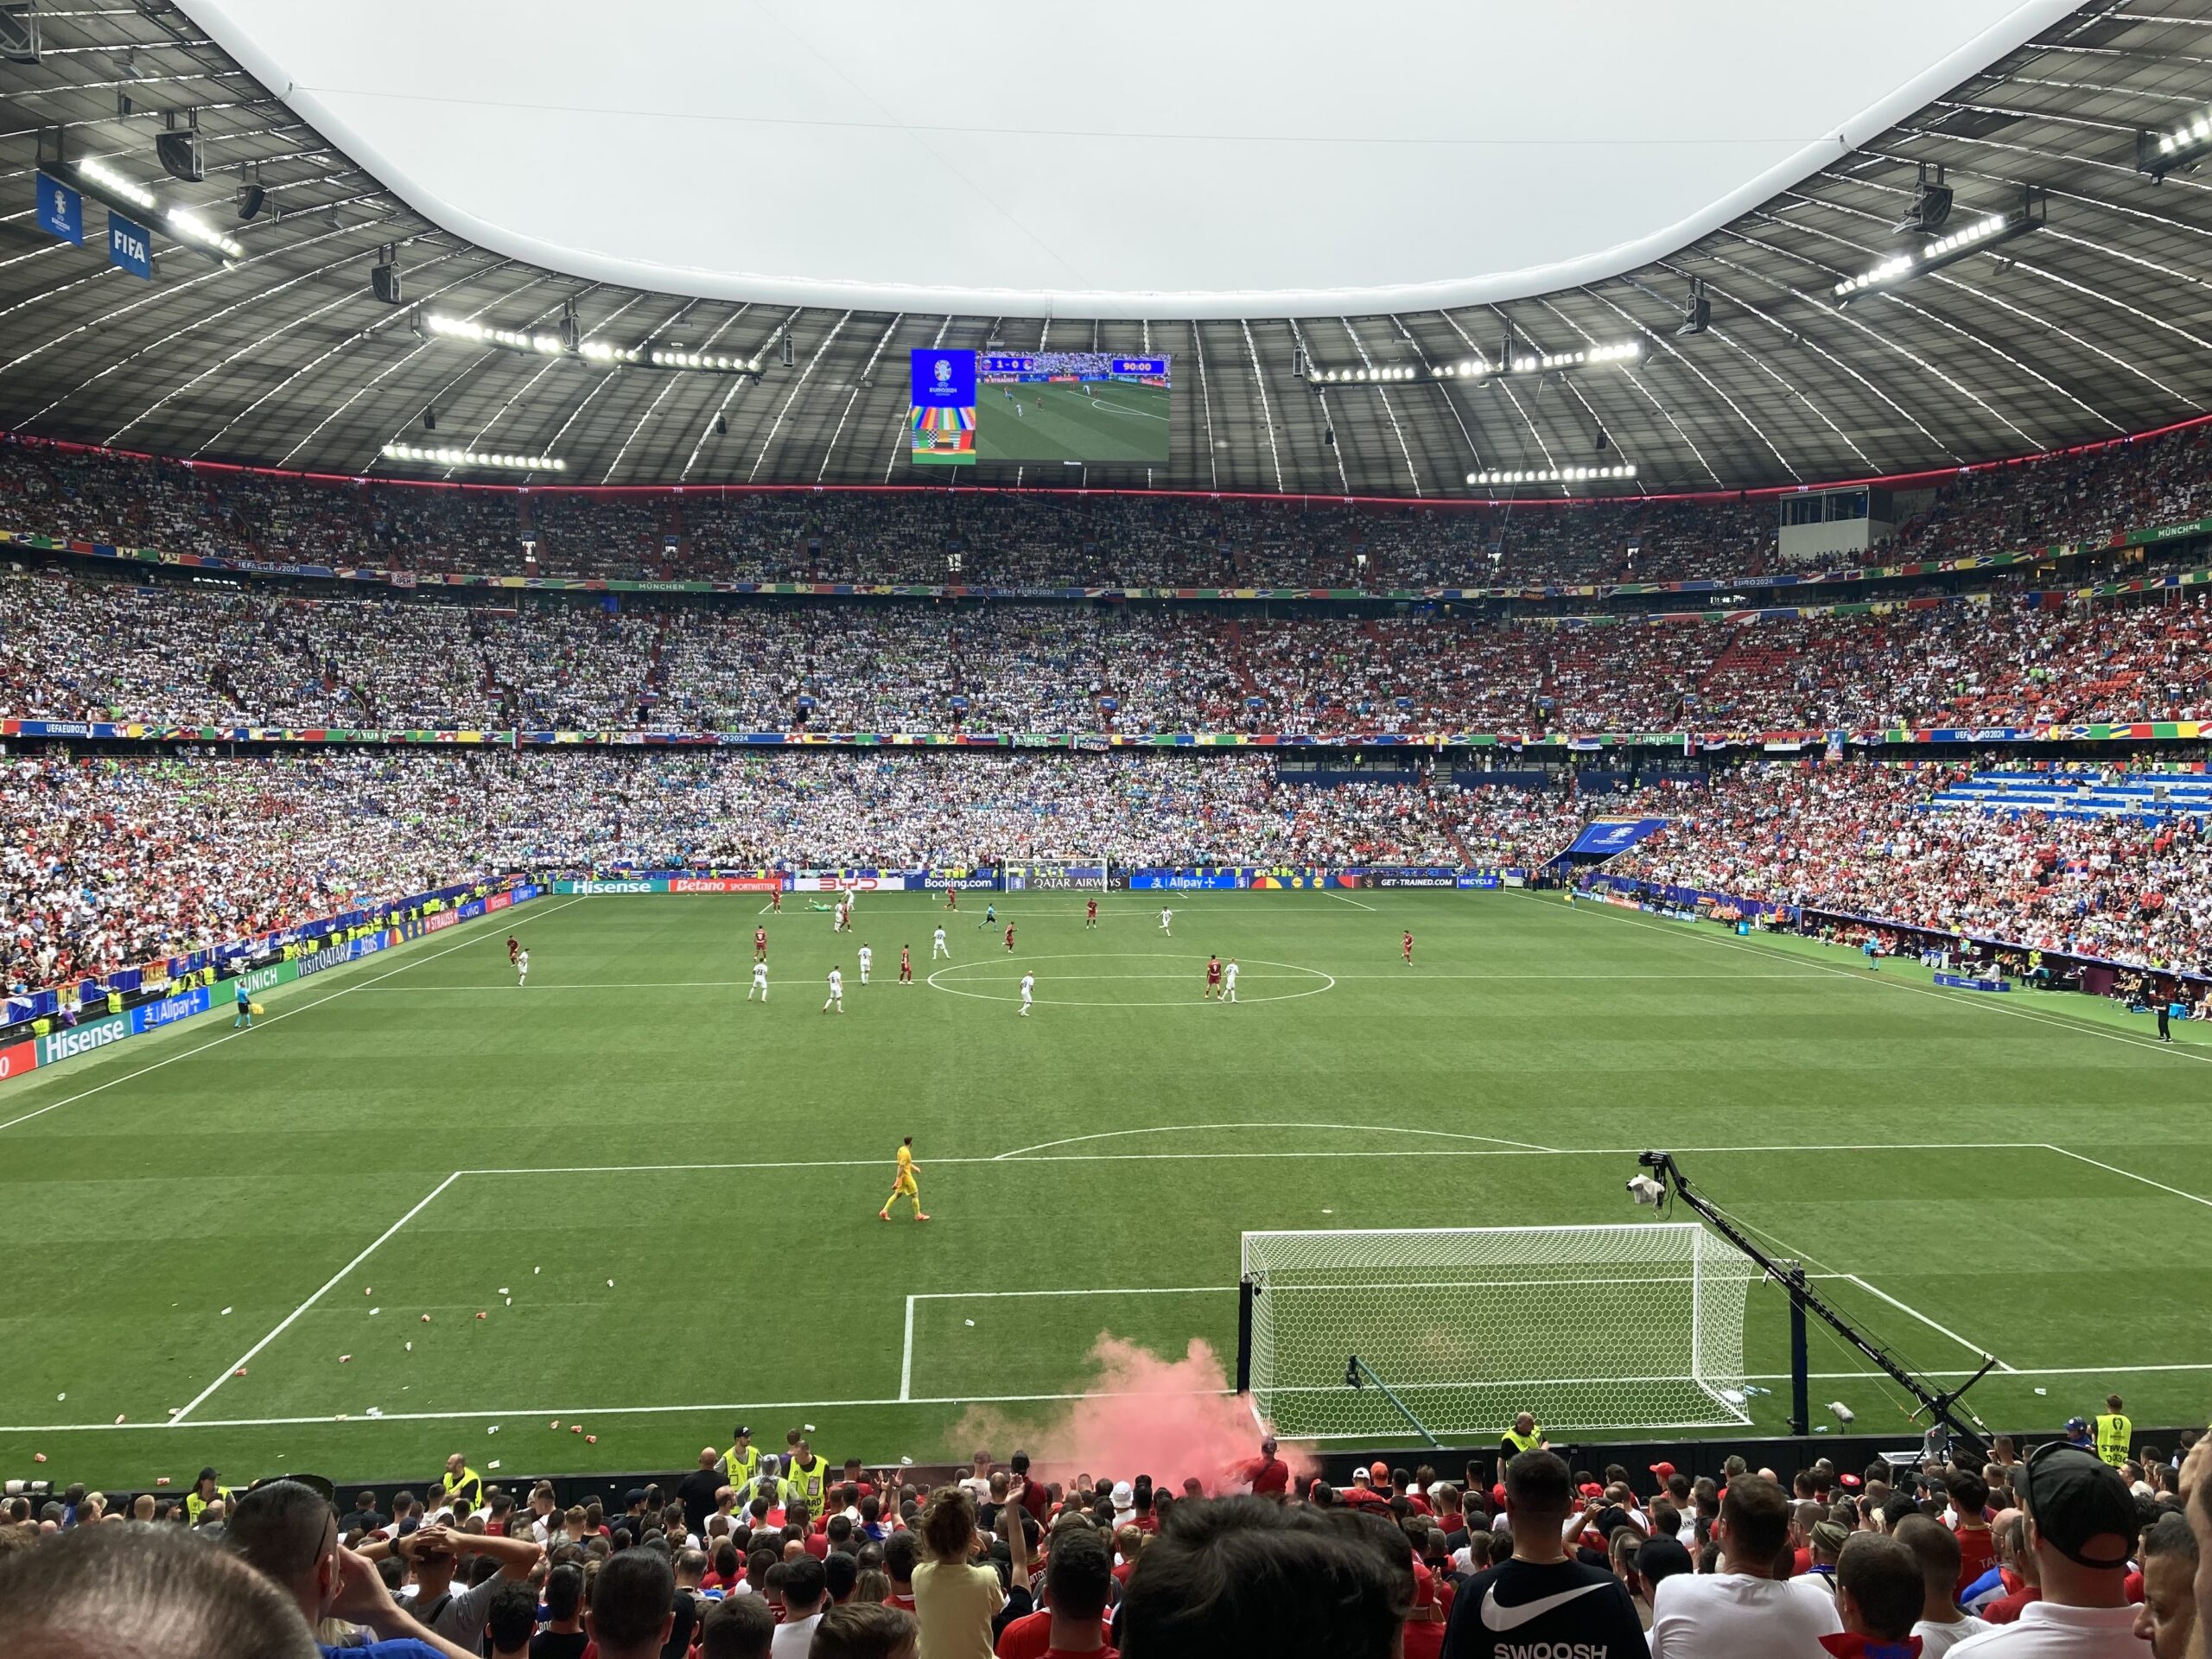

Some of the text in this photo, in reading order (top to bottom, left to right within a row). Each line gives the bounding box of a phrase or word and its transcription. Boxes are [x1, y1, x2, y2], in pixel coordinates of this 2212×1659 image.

[114, 229, 146, 263] FIFA
[1123, 362, 1151, 372] 90:00
[573, 881, 651, 893] Hisense
[677, 880, 776, 892] Betano SPORTWETTEN
[820, 878, 878, 890] BYD
[925, 878, 992, 890] Booking.com
[1034, 877, 1121, 889] QATAR AIRWAYS
[1381, 878, 1452, 887] GET-TRAINED.COM
[431, 912, 454, 931] STRAUSS
[361, 935, 377, 957] Atos
[234, 967, 277, 997] MUNICH
[46, 1020, 124, 1064] Hisense
[1494, 1643, 1607, 1659] SWOOSH
